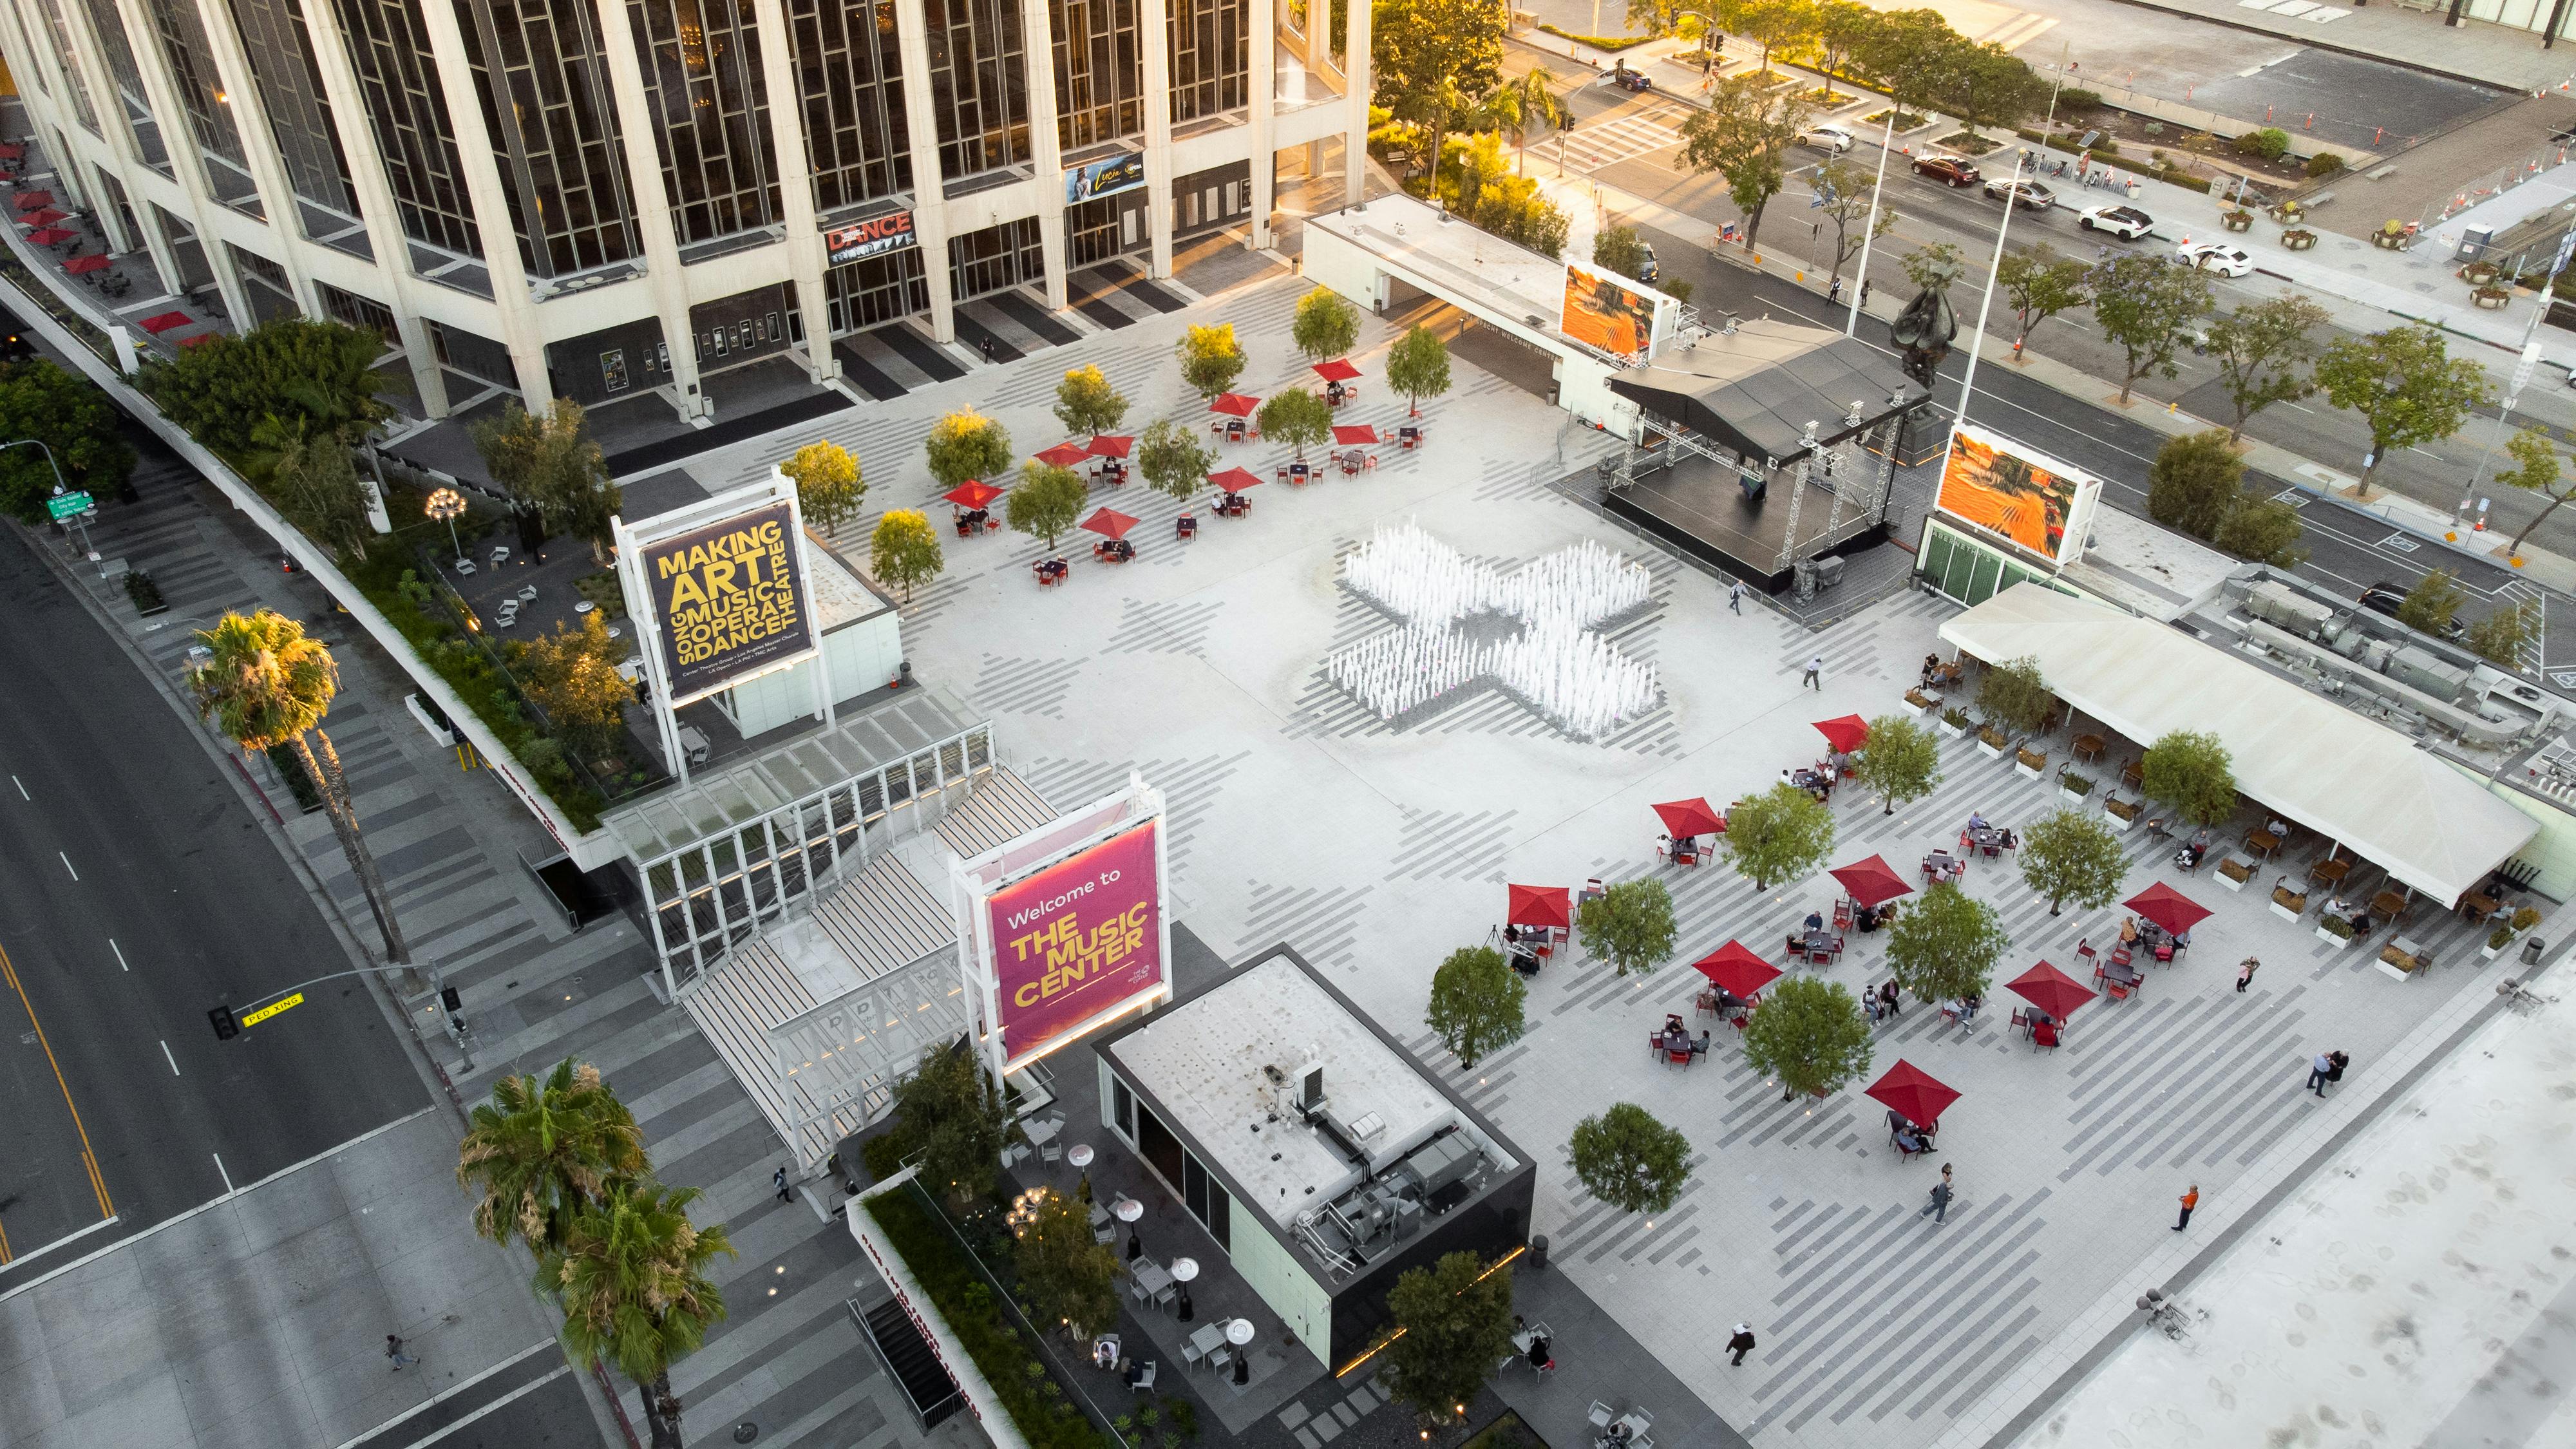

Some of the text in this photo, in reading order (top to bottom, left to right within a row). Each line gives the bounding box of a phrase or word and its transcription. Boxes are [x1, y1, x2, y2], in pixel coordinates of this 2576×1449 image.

[1095, 166, 1122, 191] Lucia
[828, 212, 911, 251] DANCE
[1501, 332, 1531, 350] WELCOME
[658, 520, 782, 580] MAKING
[1932, 529, 1991, 562] ABERNETHY'S
[670, 547, 766, 614] ART
[769, 540, 797, 630] THEATRE
[686, 581, 775, 627] MUSIC
[690, 600, 779, 643] OPERA
[670, 612, 695, 665] SONG
[682, 668, 699, 677] Center
[699, 662, 718, 670] Theatre
[719, 657, 734, 665] Group
[746, 645, 764, 654] Angeles
[764, 639, 781, 648] Master
[781, 632, 799, 641] Chorale
[694, 617, 782, 662] DANCE
[1007, 869, 1121, 930] Welcome to
[1009, 912, 1080, 962] THE
[1045, 900, 1148, 974] MUSIC
[1014, 927, 1144, 1008] CENTER
[249, 997, 298, 1023] PED XING
